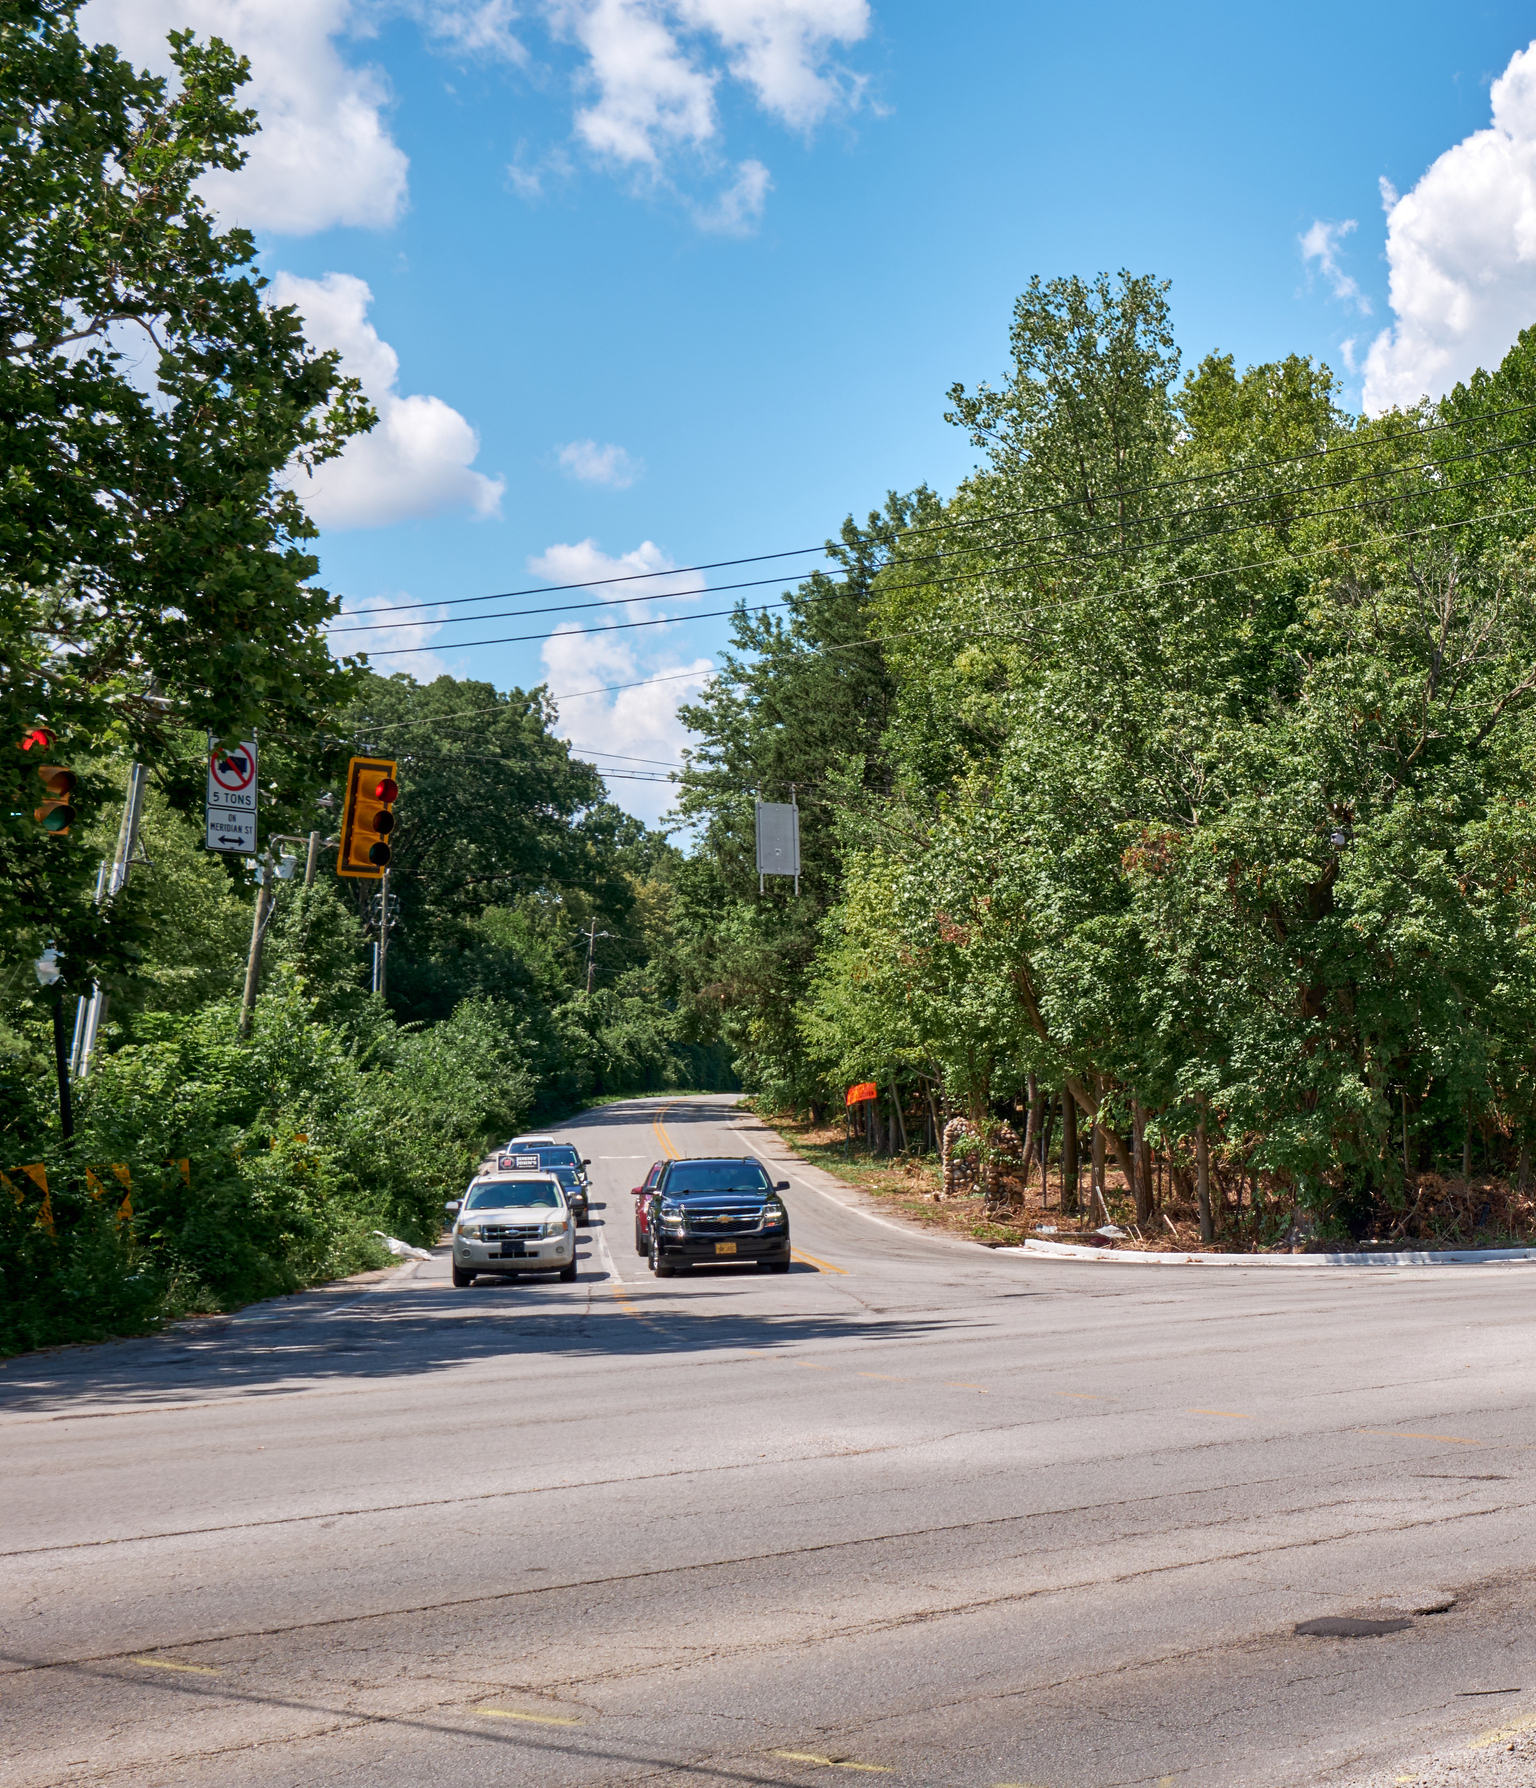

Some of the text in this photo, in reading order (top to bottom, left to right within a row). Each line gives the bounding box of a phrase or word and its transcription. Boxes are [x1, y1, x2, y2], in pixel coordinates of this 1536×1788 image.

[213, 791, 252, 806] 5 TONS
[228, 813, 237, 822] ON
[210, 822, 253, 835] MERIDIAN ST
